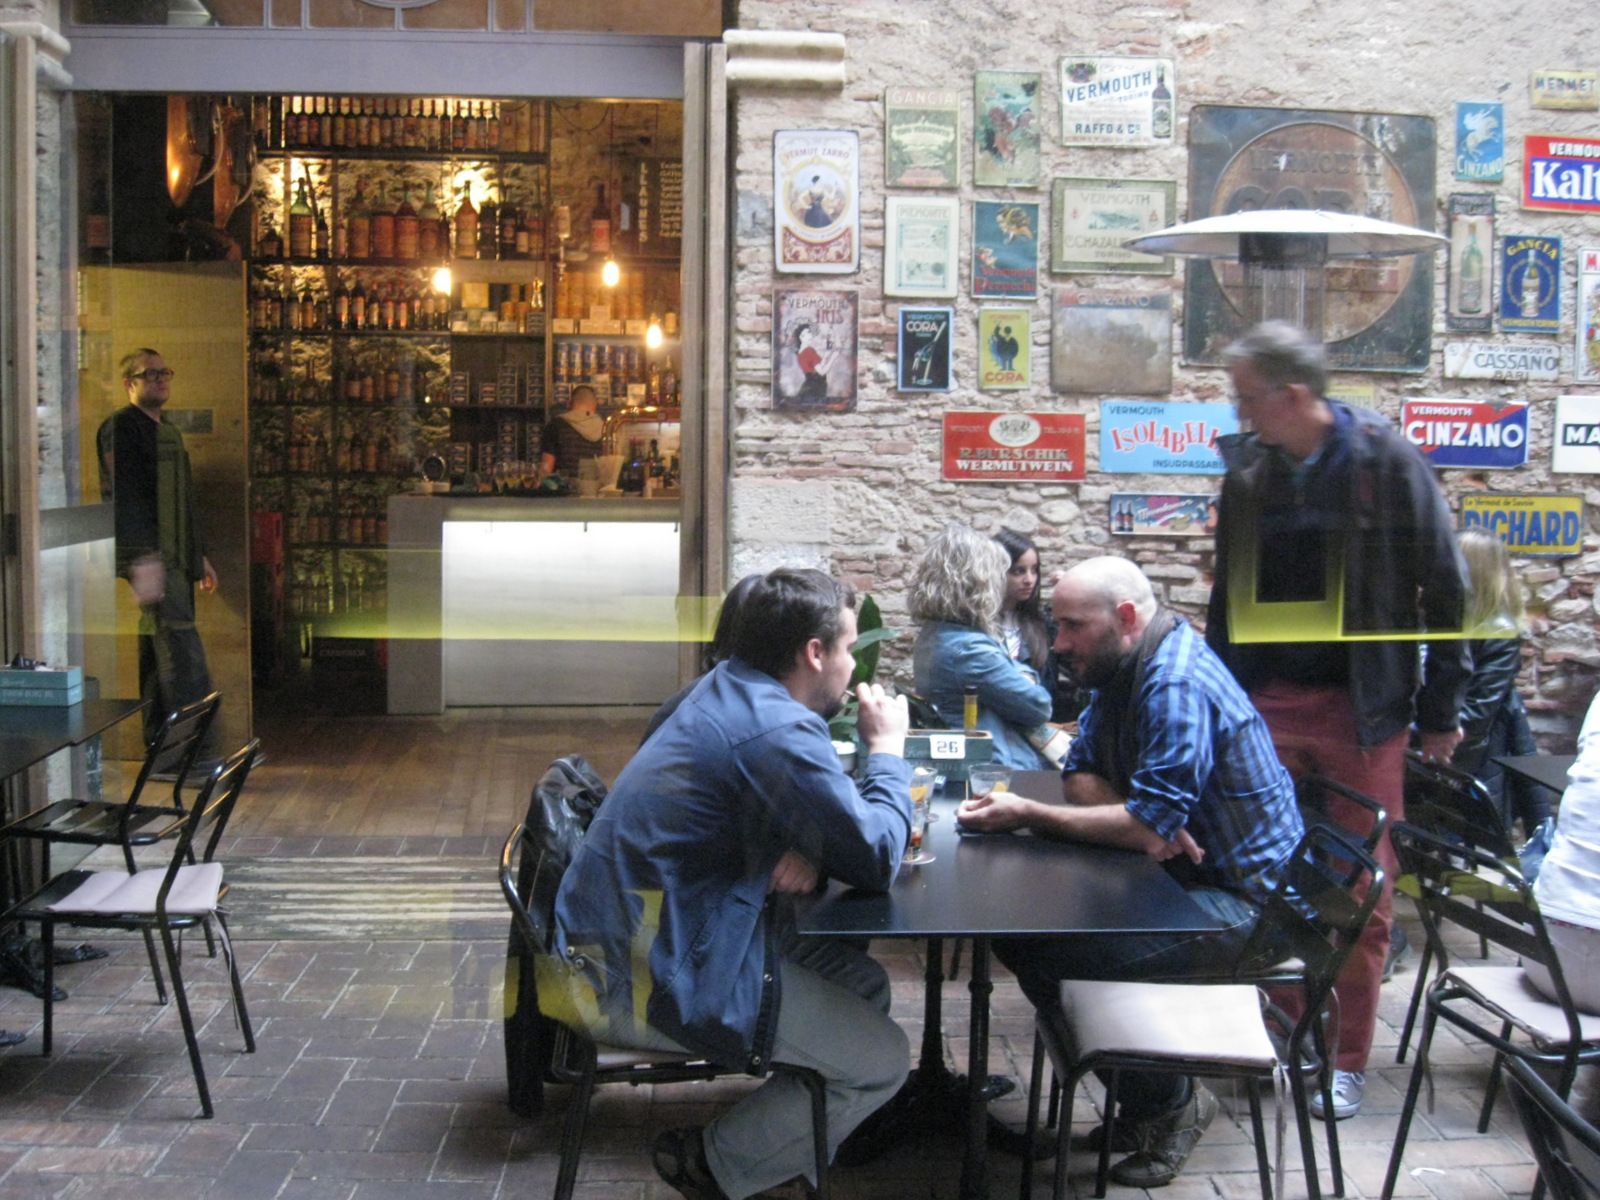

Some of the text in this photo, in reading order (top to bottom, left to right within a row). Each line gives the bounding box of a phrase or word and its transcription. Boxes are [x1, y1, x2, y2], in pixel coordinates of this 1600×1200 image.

[1067, 71, 1152, 103] VERMOUTH
[892, 90, 954, 105] GANCIA
[1075, 123, 1114, 134] RAFFO
[1116, 123, 1124, 134] &
[1456, 154, 1504, 178] CINZANO
[1080, 193, 1151, 205] VERMOUTH
[1506, 239, 1558, 260] GANCIA
[786, 297, 849, 310] VERMOUTH
[905, 320, 938, 333] CORA
[1502, 345, 1553, 354] VERMOUTH
[1473, 353, 1559, 371] CASSANO
[984, 372, 1025, 382] CORA
[1109, 406, 1164, 415] VERMOUTH
[1411, 406, 1472, 416] VERMOUTH
[1405, 420, 1525, 448] CINZANO
[955, 459, 1073, 472] WERMUTWEIN
[937, 741, 958, 753] 26
